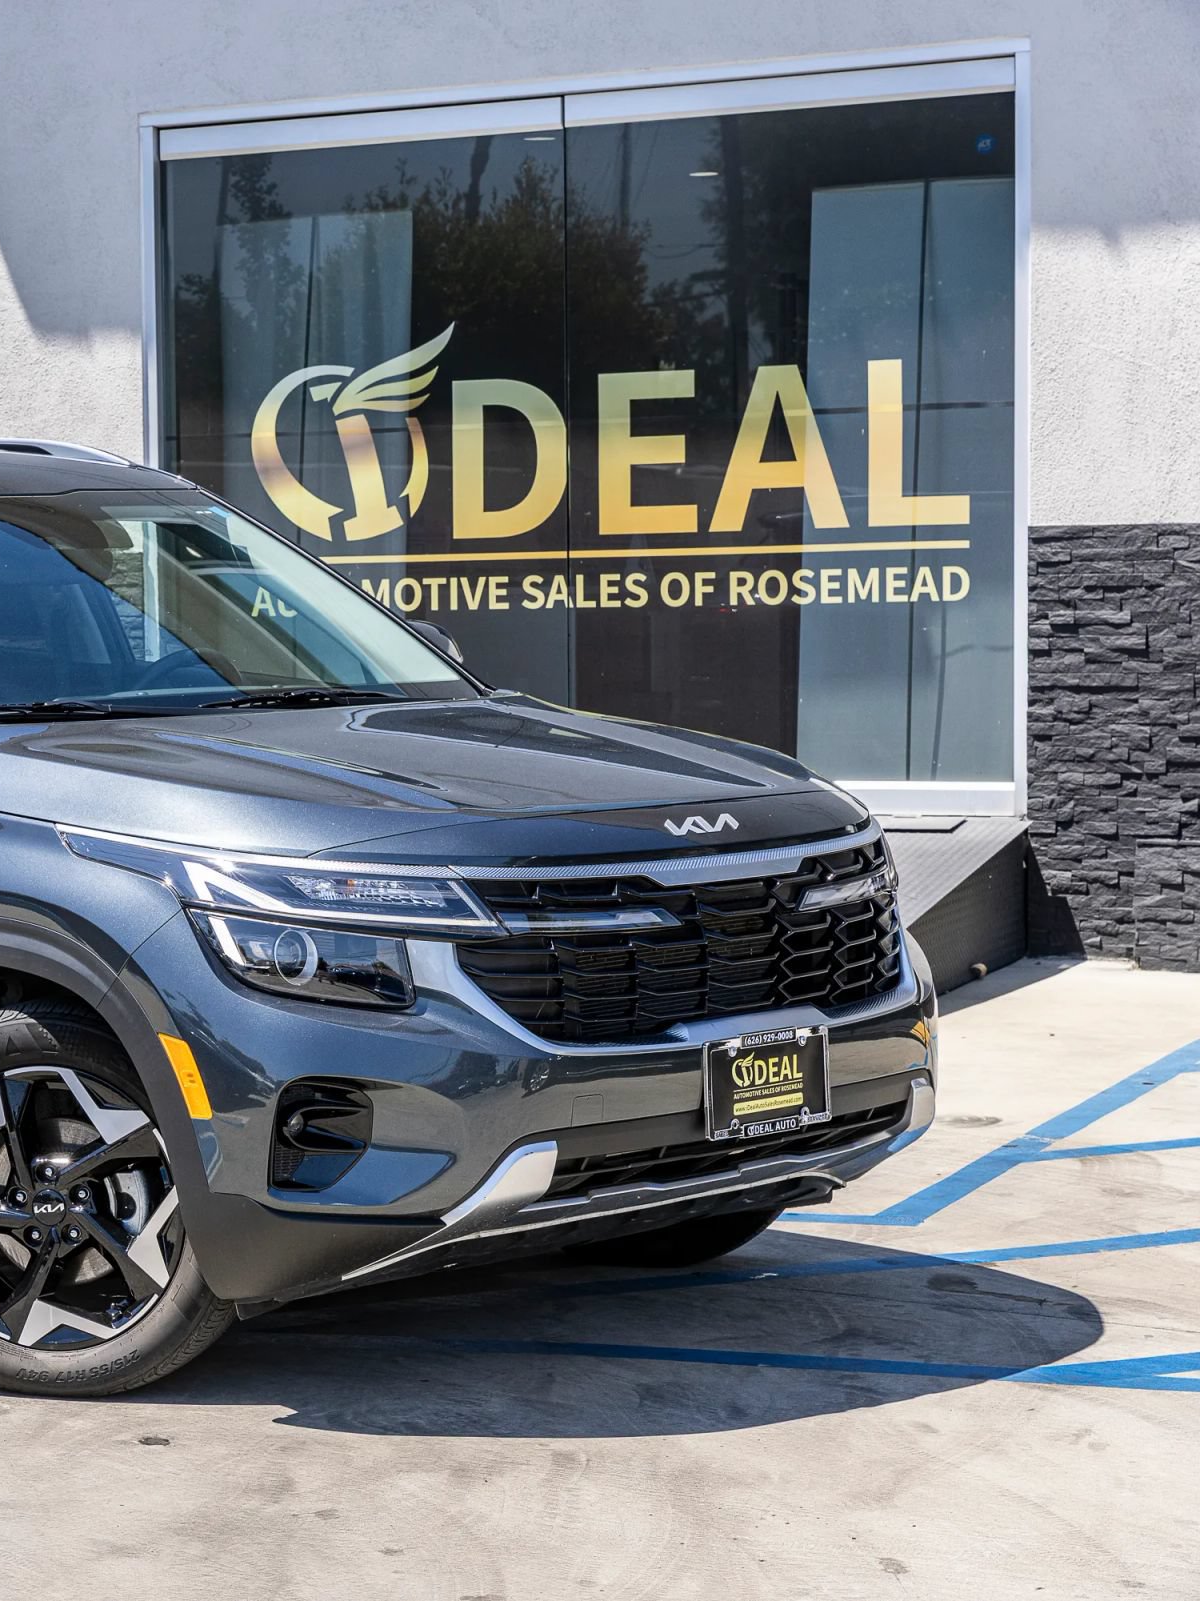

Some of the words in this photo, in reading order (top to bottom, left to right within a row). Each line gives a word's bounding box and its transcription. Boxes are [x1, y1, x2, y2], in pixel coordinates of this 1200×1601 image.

[521, 572, 649, 610] SALES
[660, 571, 717, 608] OF
[729, 566, 971, 606] ROSEMEAD
[663, 813, 740, 836] KIA
[744, 1034, 762, 1047] (626)
[734, 1090, 762, 1099] AUTOMOTIVE
[775, 1118, 797, 1130] AUTO
[33, 1203, 65, 1214] KIA
[89, 1349, 141, 1376] 215/55
